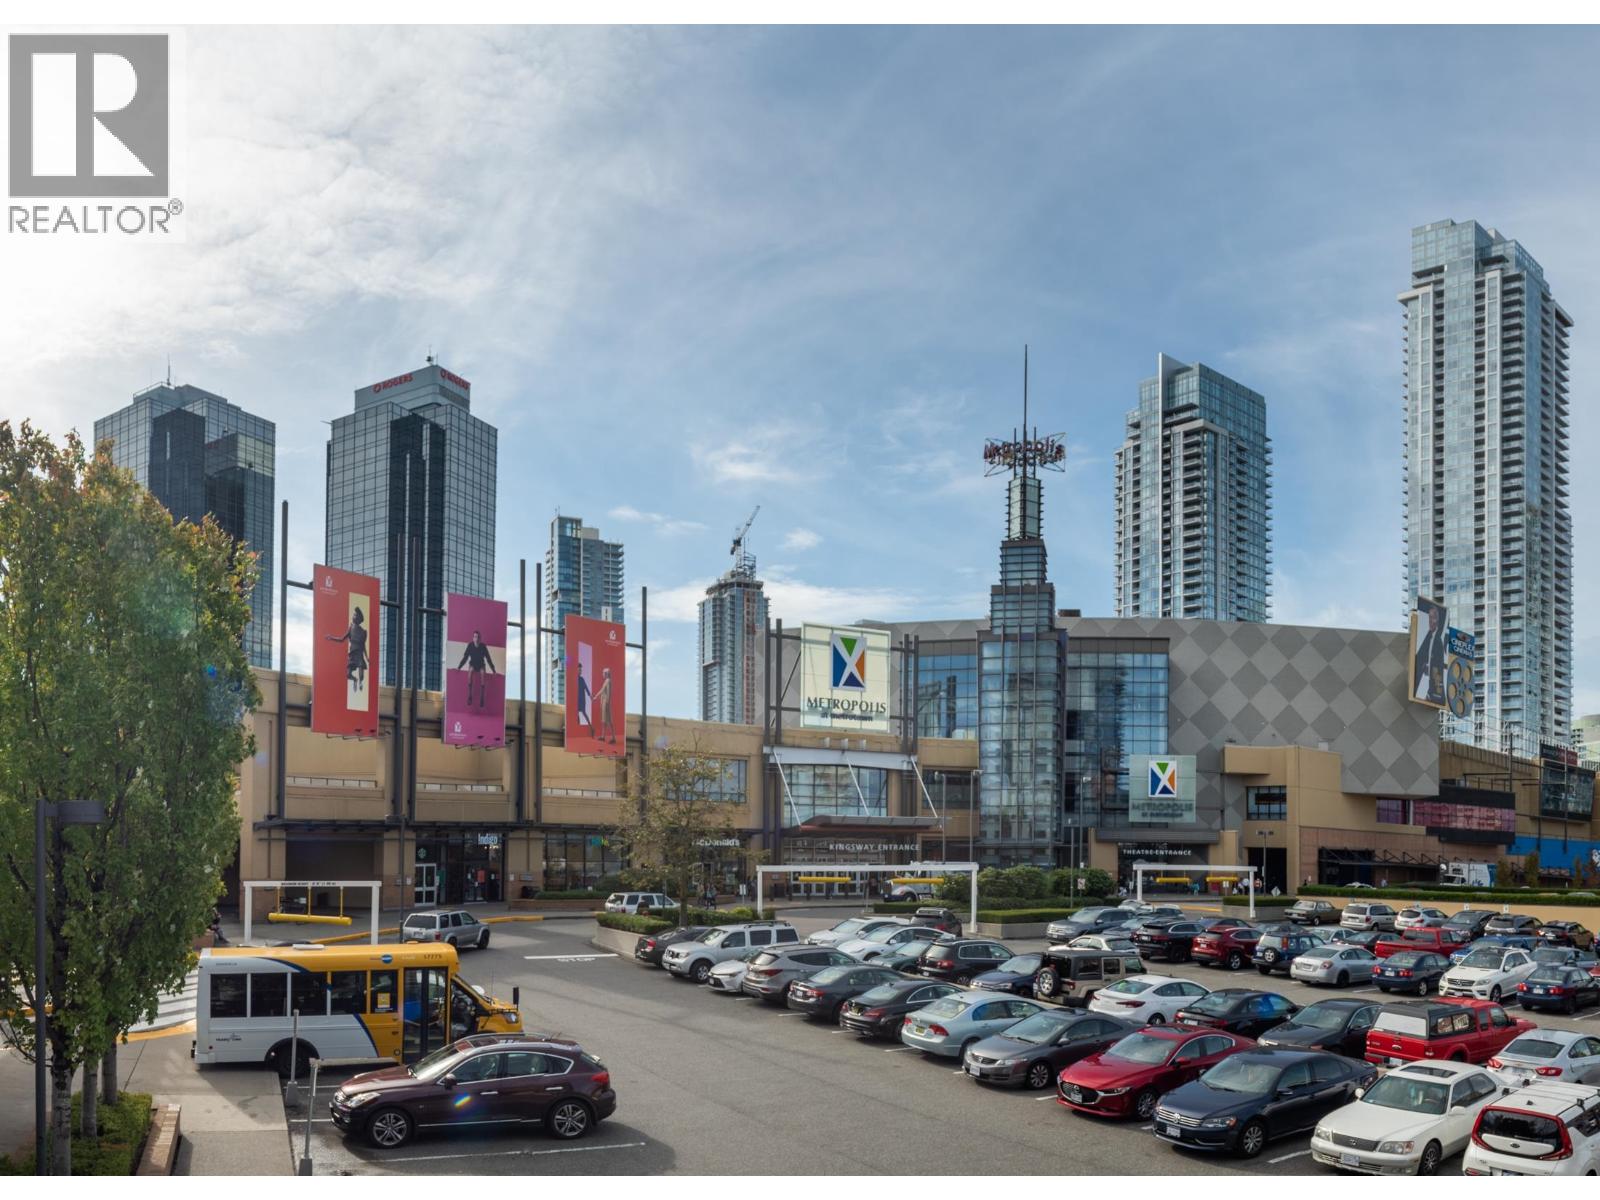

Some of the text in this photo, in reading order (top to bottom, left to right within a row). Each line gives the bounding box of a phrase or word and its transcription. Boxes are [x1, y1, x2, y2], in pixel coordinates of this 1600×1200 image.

[806, 696, 886, 714] METROPOLIS
[478, 833, 498, 845] Indigo
[829, 842, 920, 851] KINGSWAY ENTRANCE
[1123, 848, 1154, 856] THEATRE
